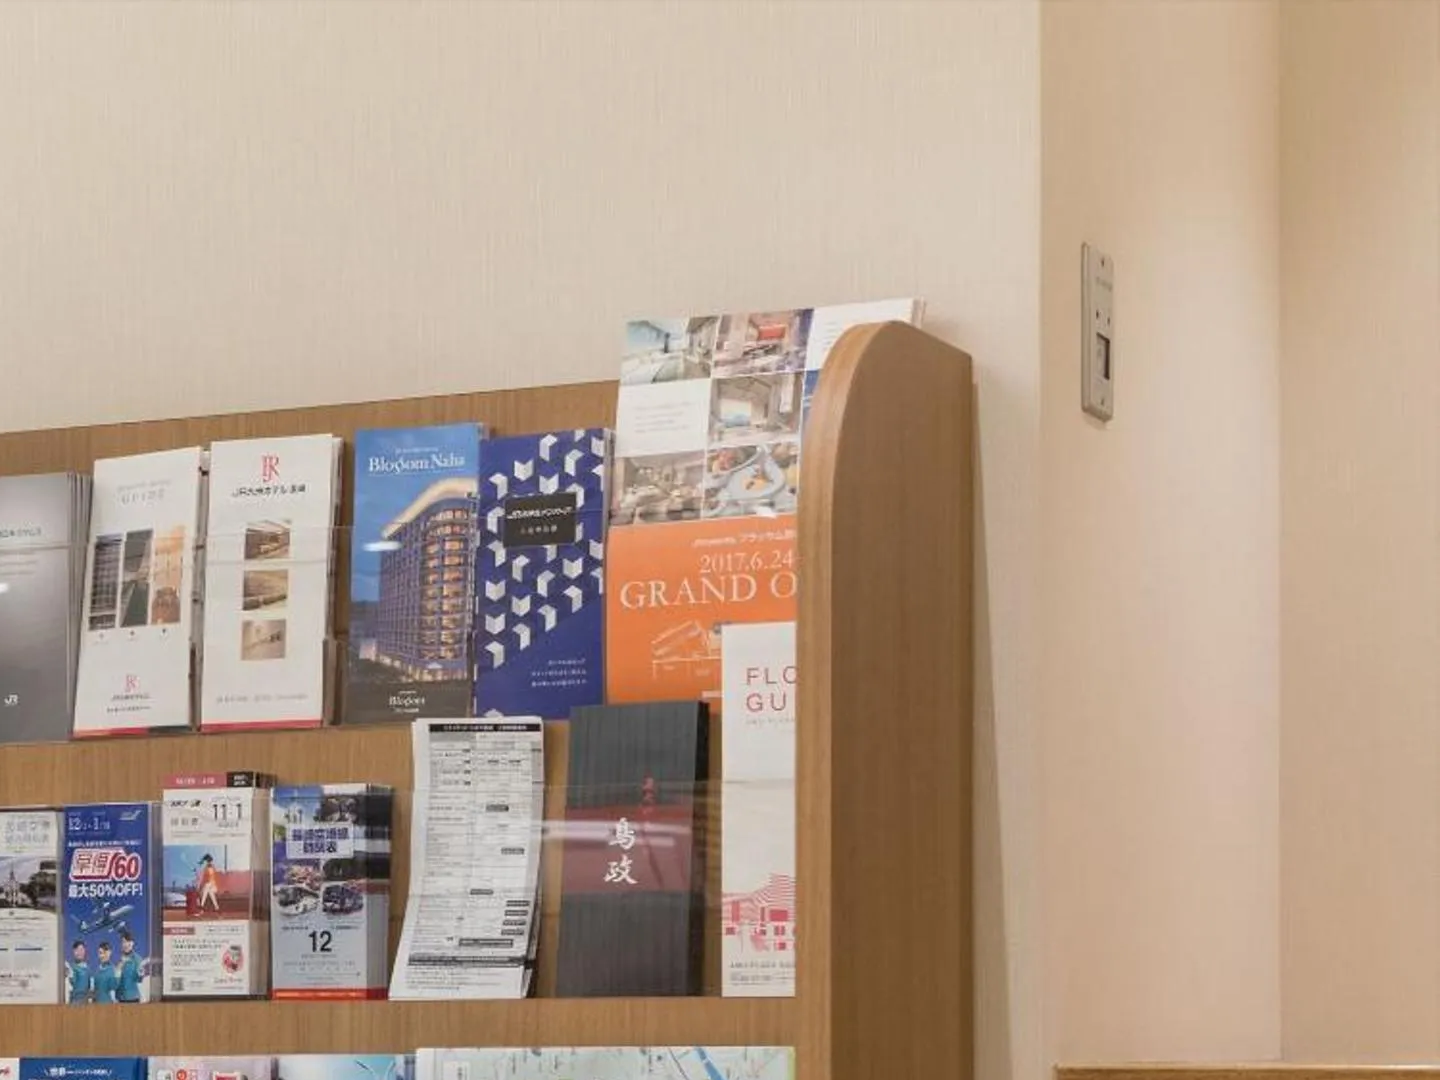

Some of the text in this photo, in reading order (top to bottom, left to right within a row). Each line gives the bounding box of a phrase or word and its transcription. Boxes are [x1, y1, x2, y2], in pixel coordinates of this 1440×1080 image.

[699, 549, 793, 574] 2017.6.24
[620, 573, 757, 610] GRAND
[68, 883, 144, 898] 最大50%OFF!
[308, 930, 333, 953] 12
